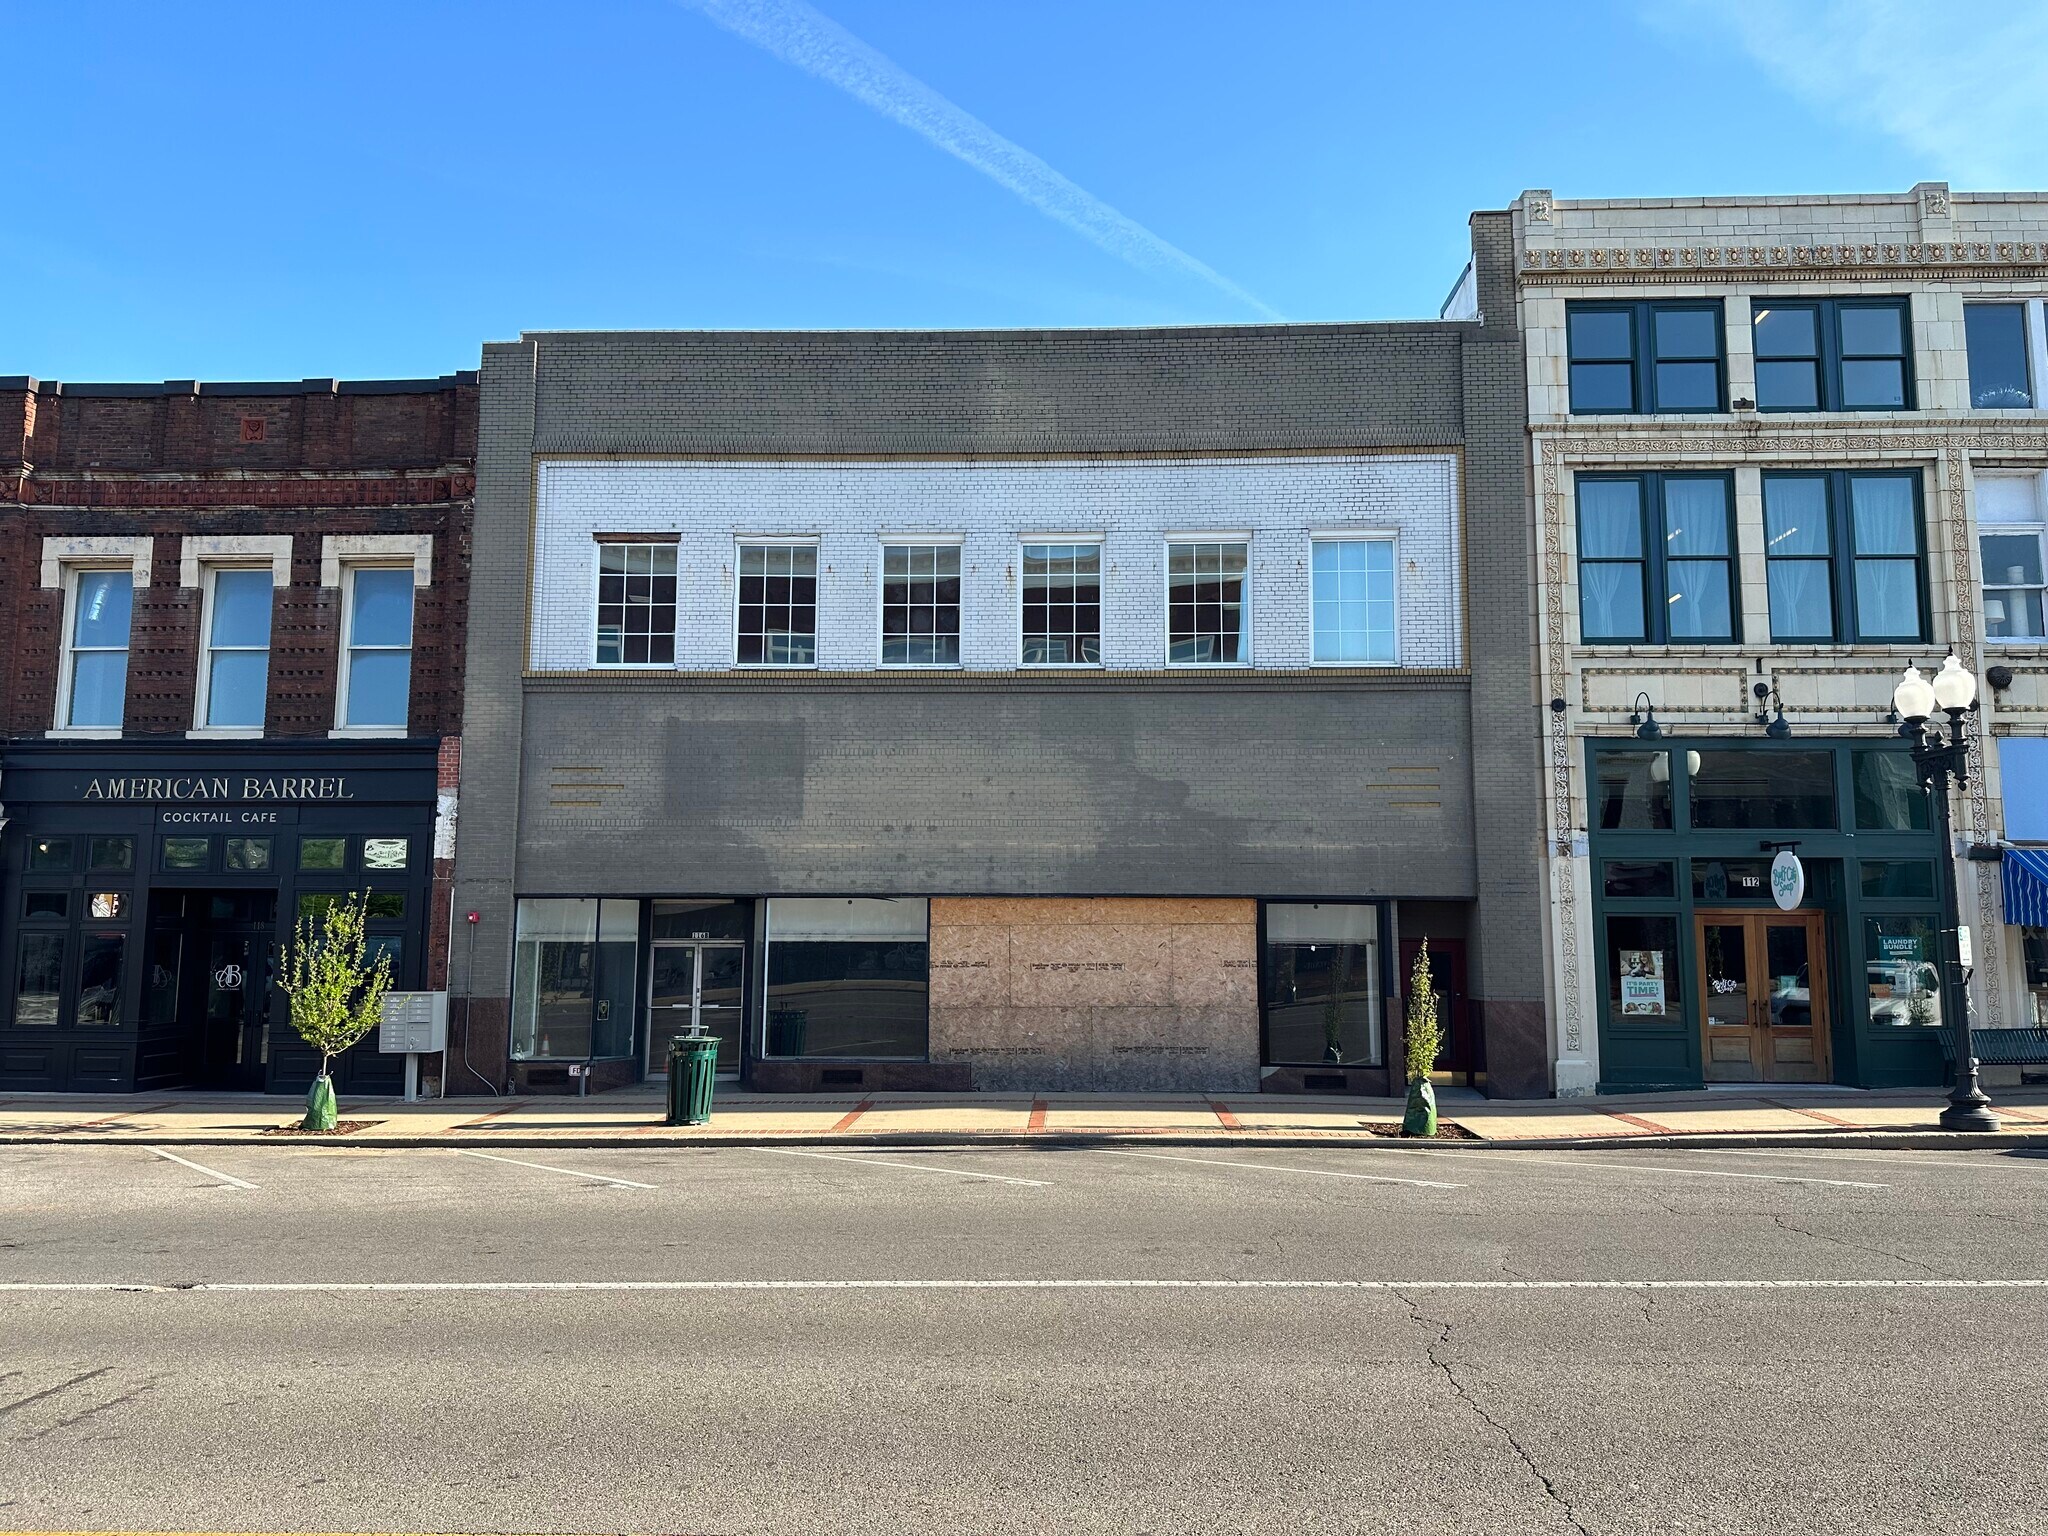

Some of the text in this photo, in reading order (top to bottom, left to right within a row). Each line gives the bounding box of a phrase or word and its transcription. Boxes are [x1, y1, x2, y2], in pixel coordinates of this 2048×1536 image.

[83, 777, 354, 800] AMERICAN BARREL
[162, 812, 277, 823] COCKTAIL CAFE
[1744, 877, 1759, 887] 112
[1627, 986, 1659, 995] TIME!
